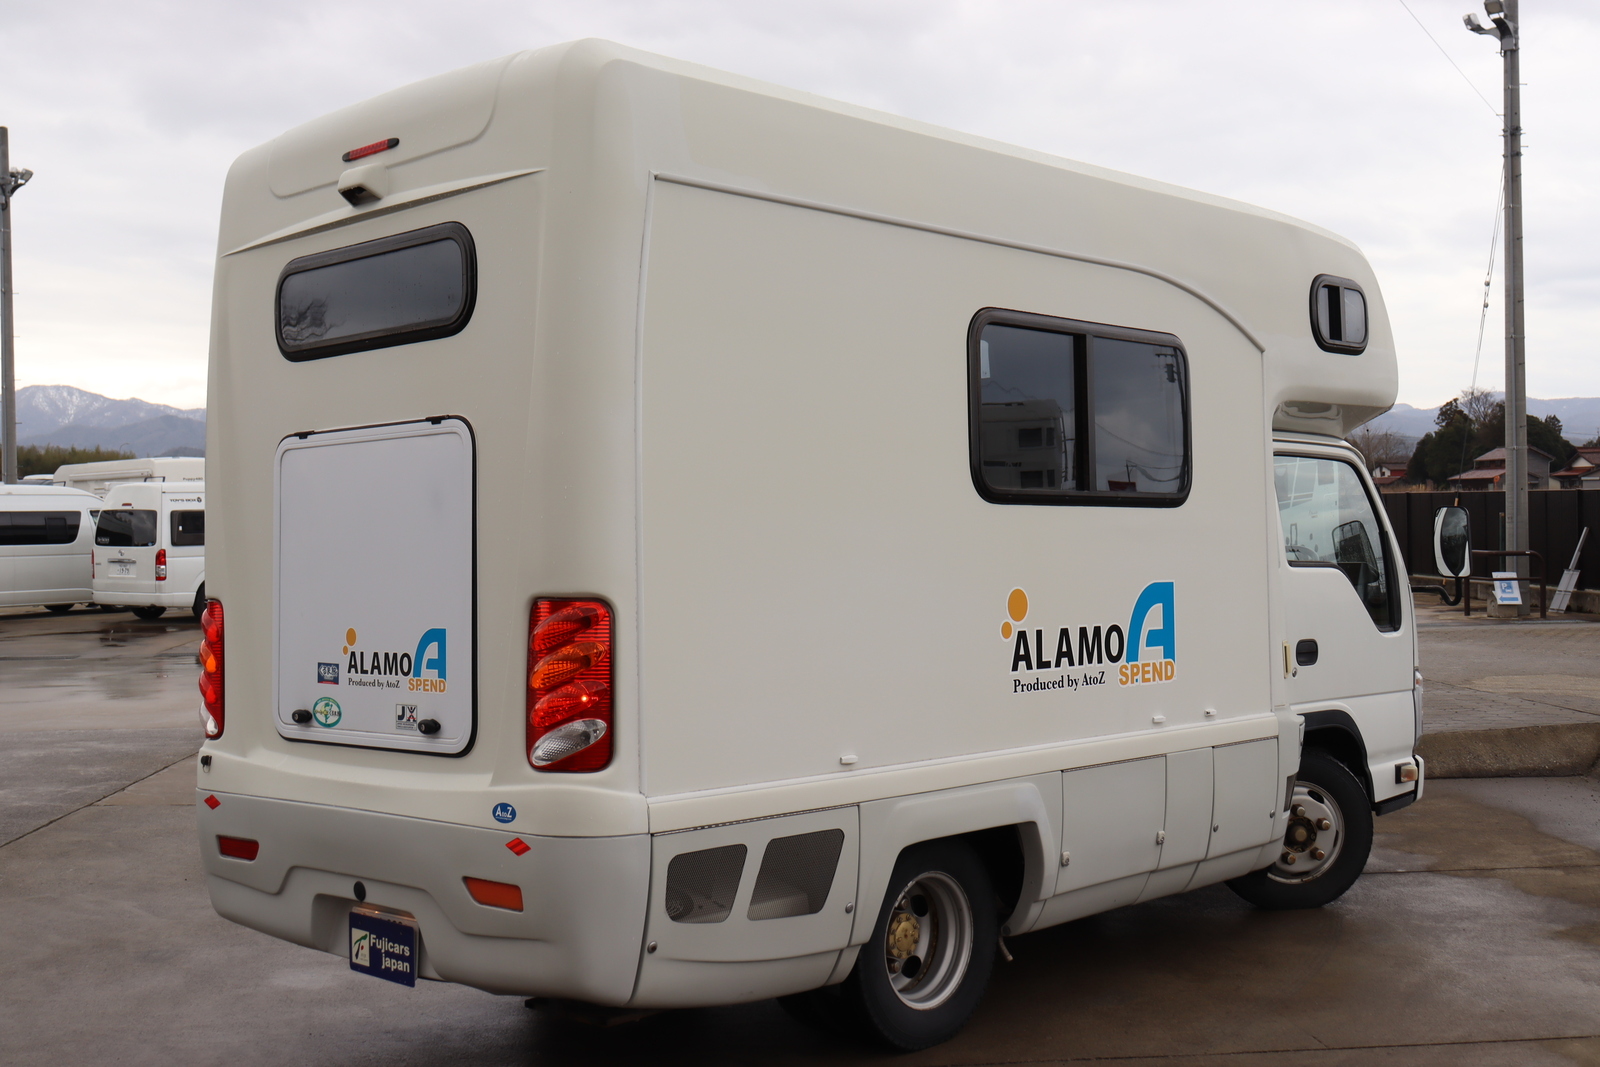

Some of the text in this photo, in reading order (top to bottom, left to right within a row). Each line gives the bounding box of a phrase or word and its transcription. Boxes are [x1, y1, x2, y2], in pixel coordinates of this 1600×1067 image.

[1011, 624, 1125, 672] ALAMO
[347, 651, 412, 677] ALAMO
[1118, 660, 1175, 686] SPEND
[348, 678, 400, 690] Produced by AtoZ
[408, 678, 446, 693] SPEND
[1013, 671, 1106, 693] Produced by AtoZ
[370, 934, 410, 957] Fujicars
[381, 953, 410, 973] japan
